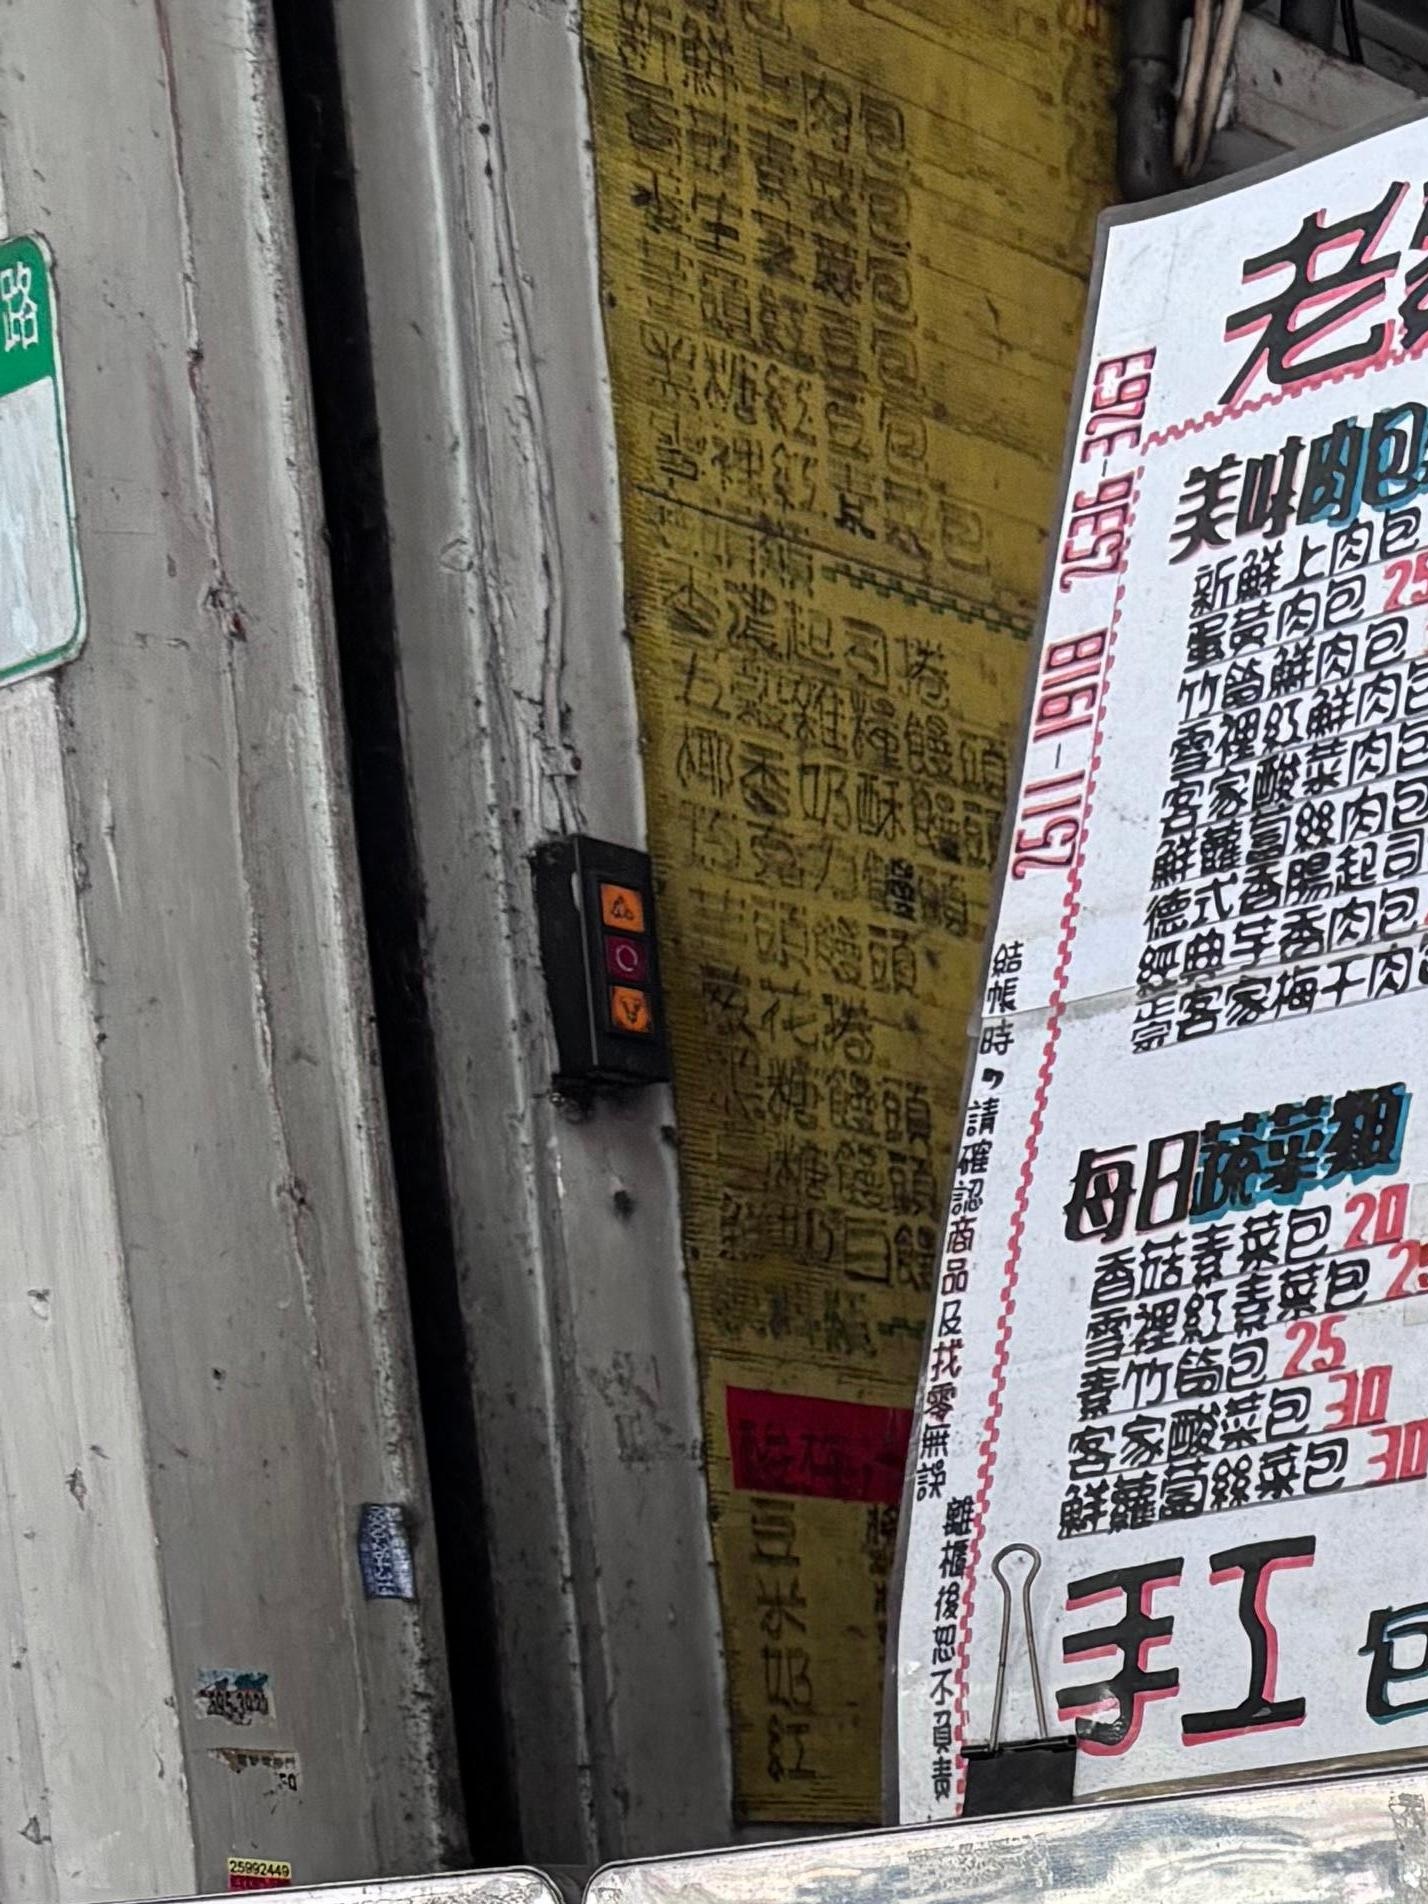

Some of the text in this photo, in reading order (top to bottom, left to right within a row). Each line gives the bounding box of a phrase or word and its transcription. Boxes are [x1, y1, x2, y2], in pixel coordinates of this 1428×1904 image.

[1011, 346, 1157, 880] 2511-1918 2536-3263
[1190, 506, 1421, 618] 新鮮上肉包
[1177, 616, 1409, 724] 竹筍鮮肉包
[1184, 574, 1366, 674] 蛋黃肉包
[1135, 888, 1420, 996] 經典芋香肉包
[1063, 1081, 1410, 1243] 每日蔬菜類
[1090, 1183, 1410, 1309] 香菇素菜包 20
[1084, 1257, 1370, 1367] 雪裡紅素菜包
[1067, 1365, 1393, 1481] 客家酸菜包 30
[1077, 1315, 1347, 1423] 素竹筍包 25
[1057, 1437, 1348, 1541] 鮮蘿蔔絲菜包
[1057, 1535, 1316, 1758] 手工
